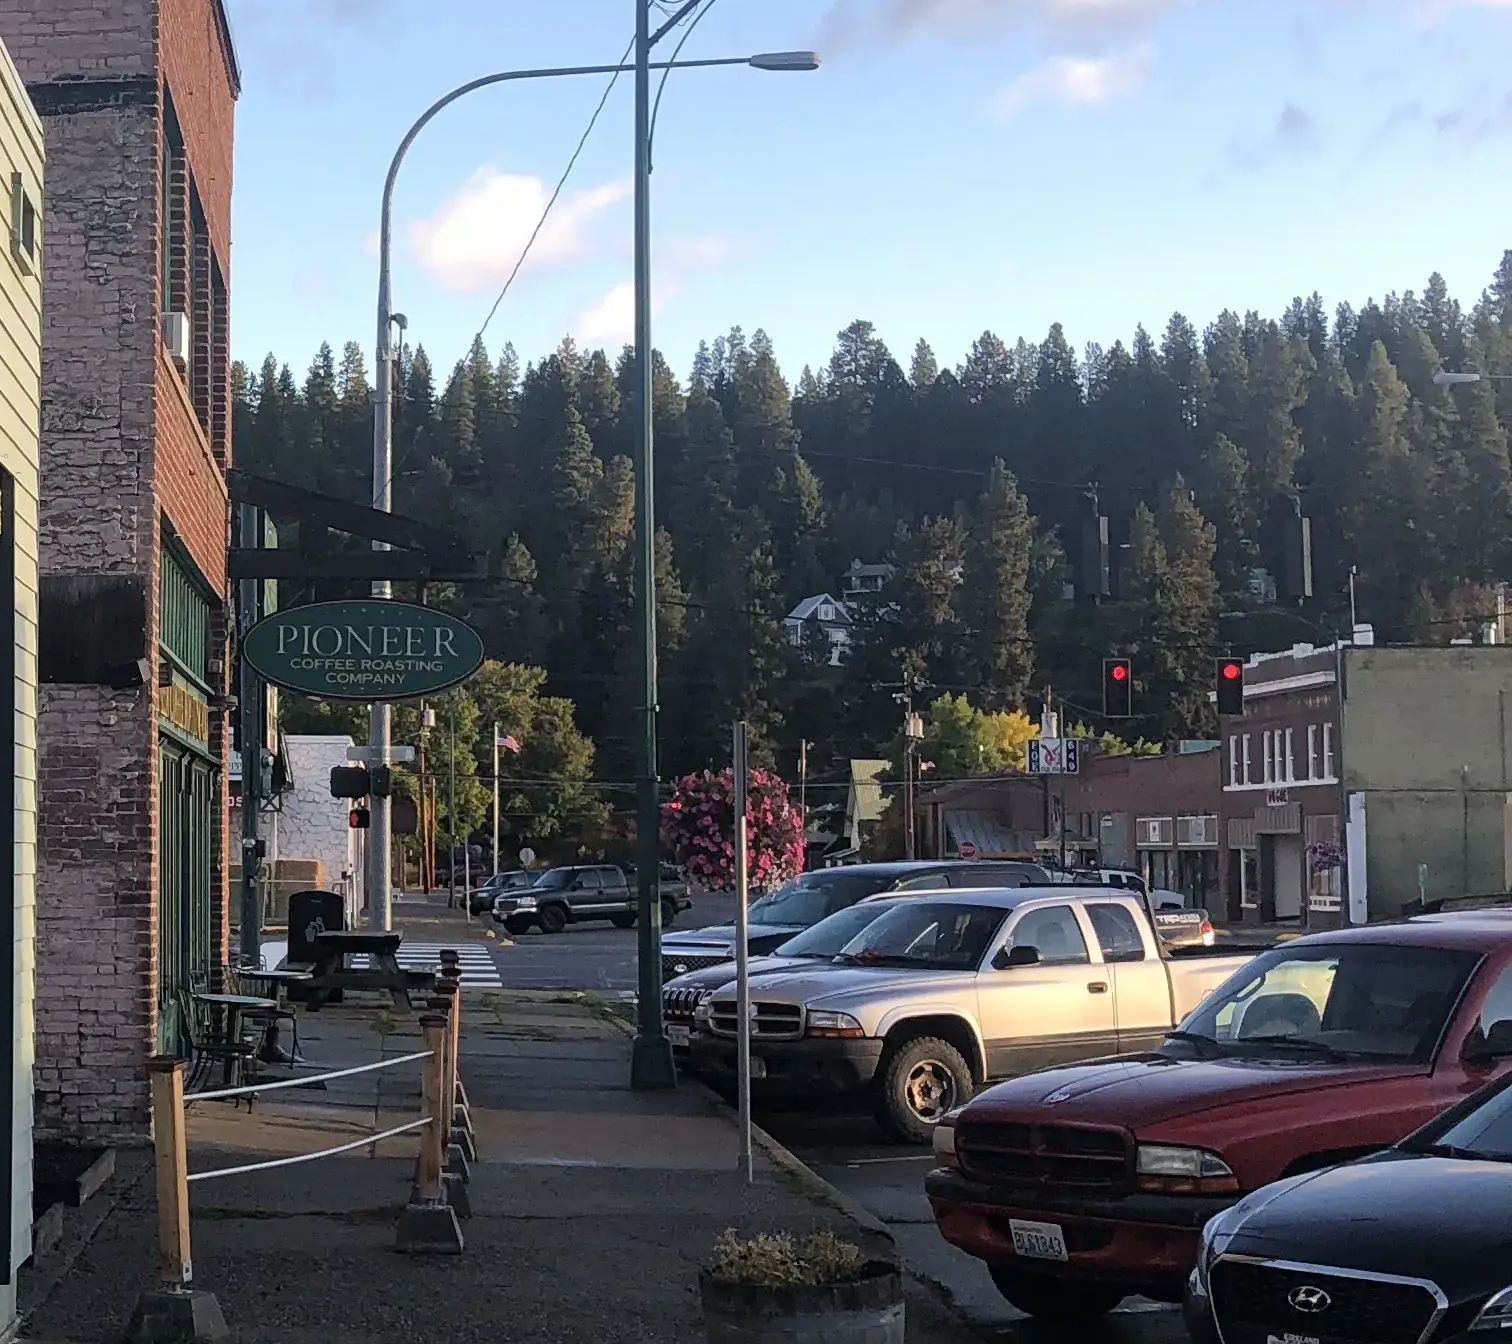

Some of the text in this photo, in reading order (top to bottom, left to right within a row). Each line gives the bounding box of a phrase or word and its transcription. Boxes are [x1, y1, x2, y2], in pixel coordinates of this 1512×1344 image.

[276, 625, 458, 657] PIONEER
[290, 658, 444, 672] COFFEE ROASTING
[326, 672, 407, 684] COMPANY
